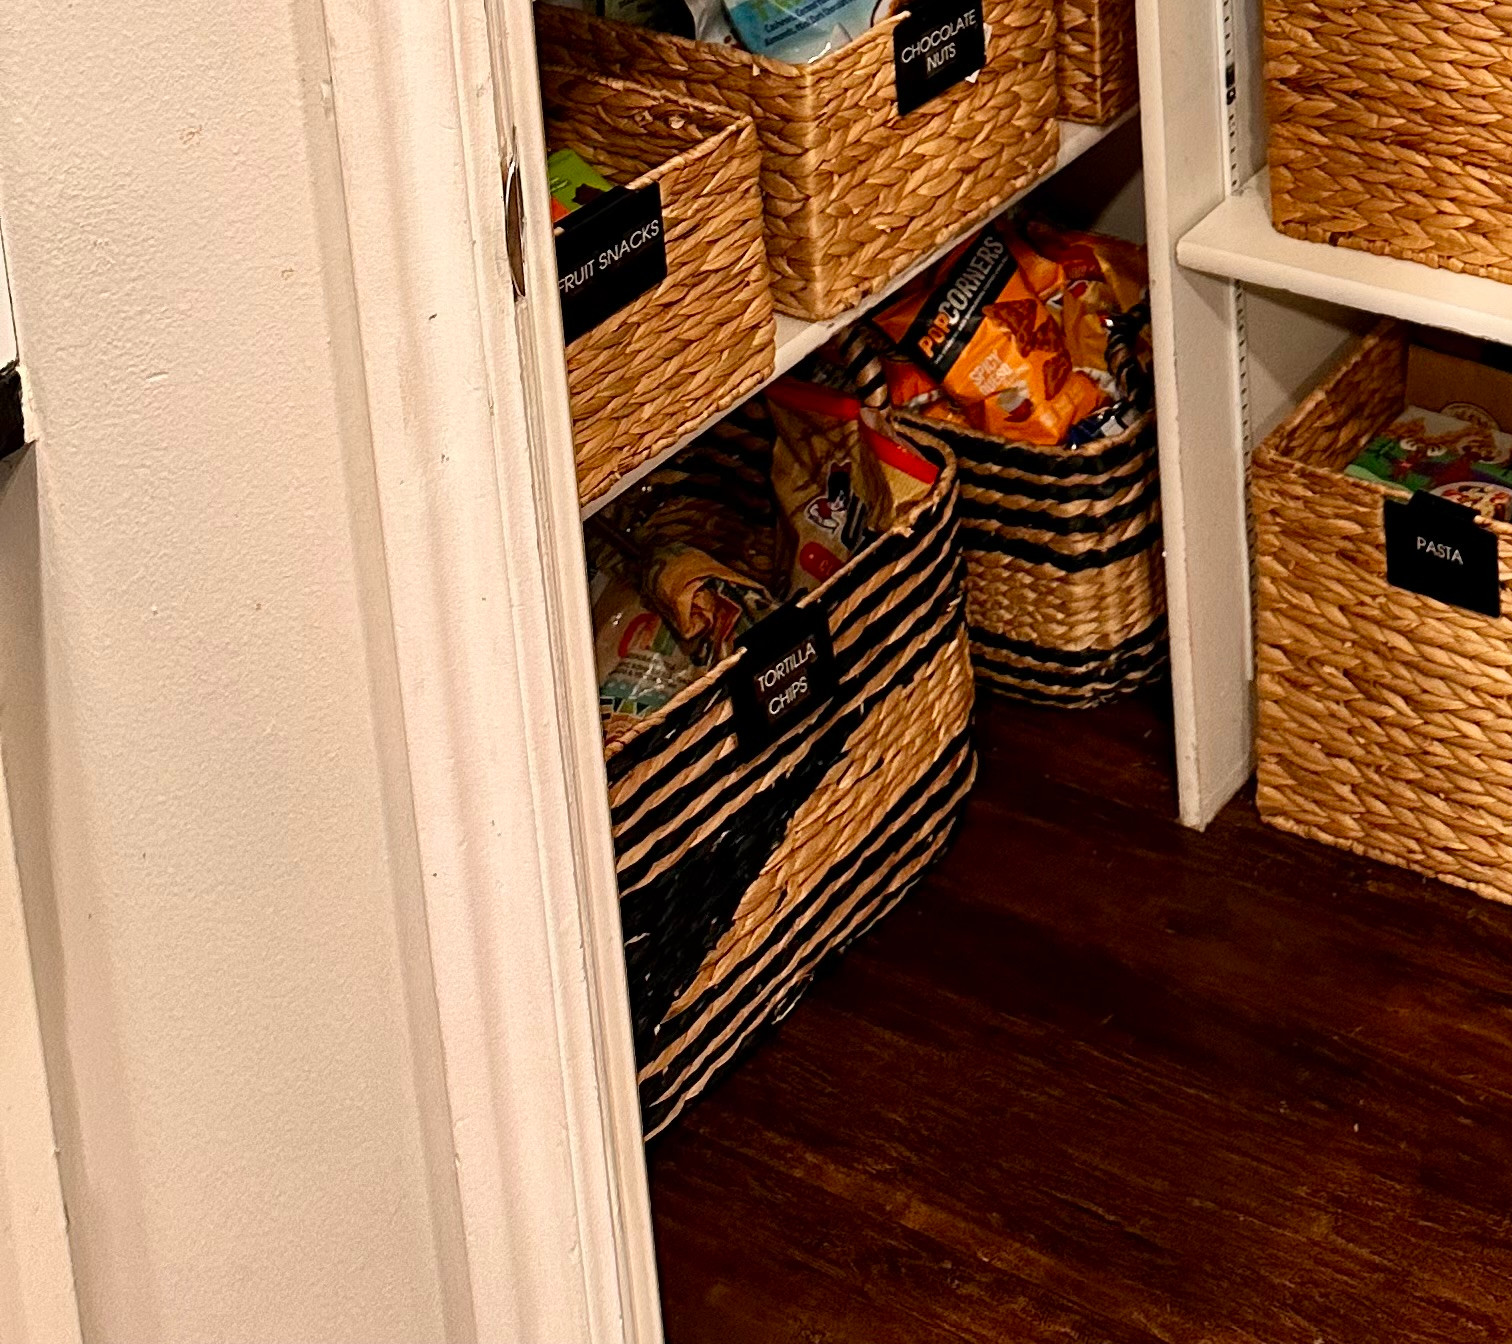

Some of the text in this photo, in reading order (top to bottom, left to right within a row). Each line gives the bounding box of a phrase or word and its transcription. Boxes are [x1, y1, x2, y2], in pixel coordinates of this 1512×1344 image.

[901, 8, 977, 64] CHOCOLATE
[926, 42, 957, 72] NUTS
[557, 218, 661, 297] FRUIT SNACKS
[917, 235, 1004, 359] POPCORNERS
[1415, 535, 1464, 567] PASTA
[756, 642, 817, 695] TORTILLA
[767, 676, 810, 717] CHIPS
